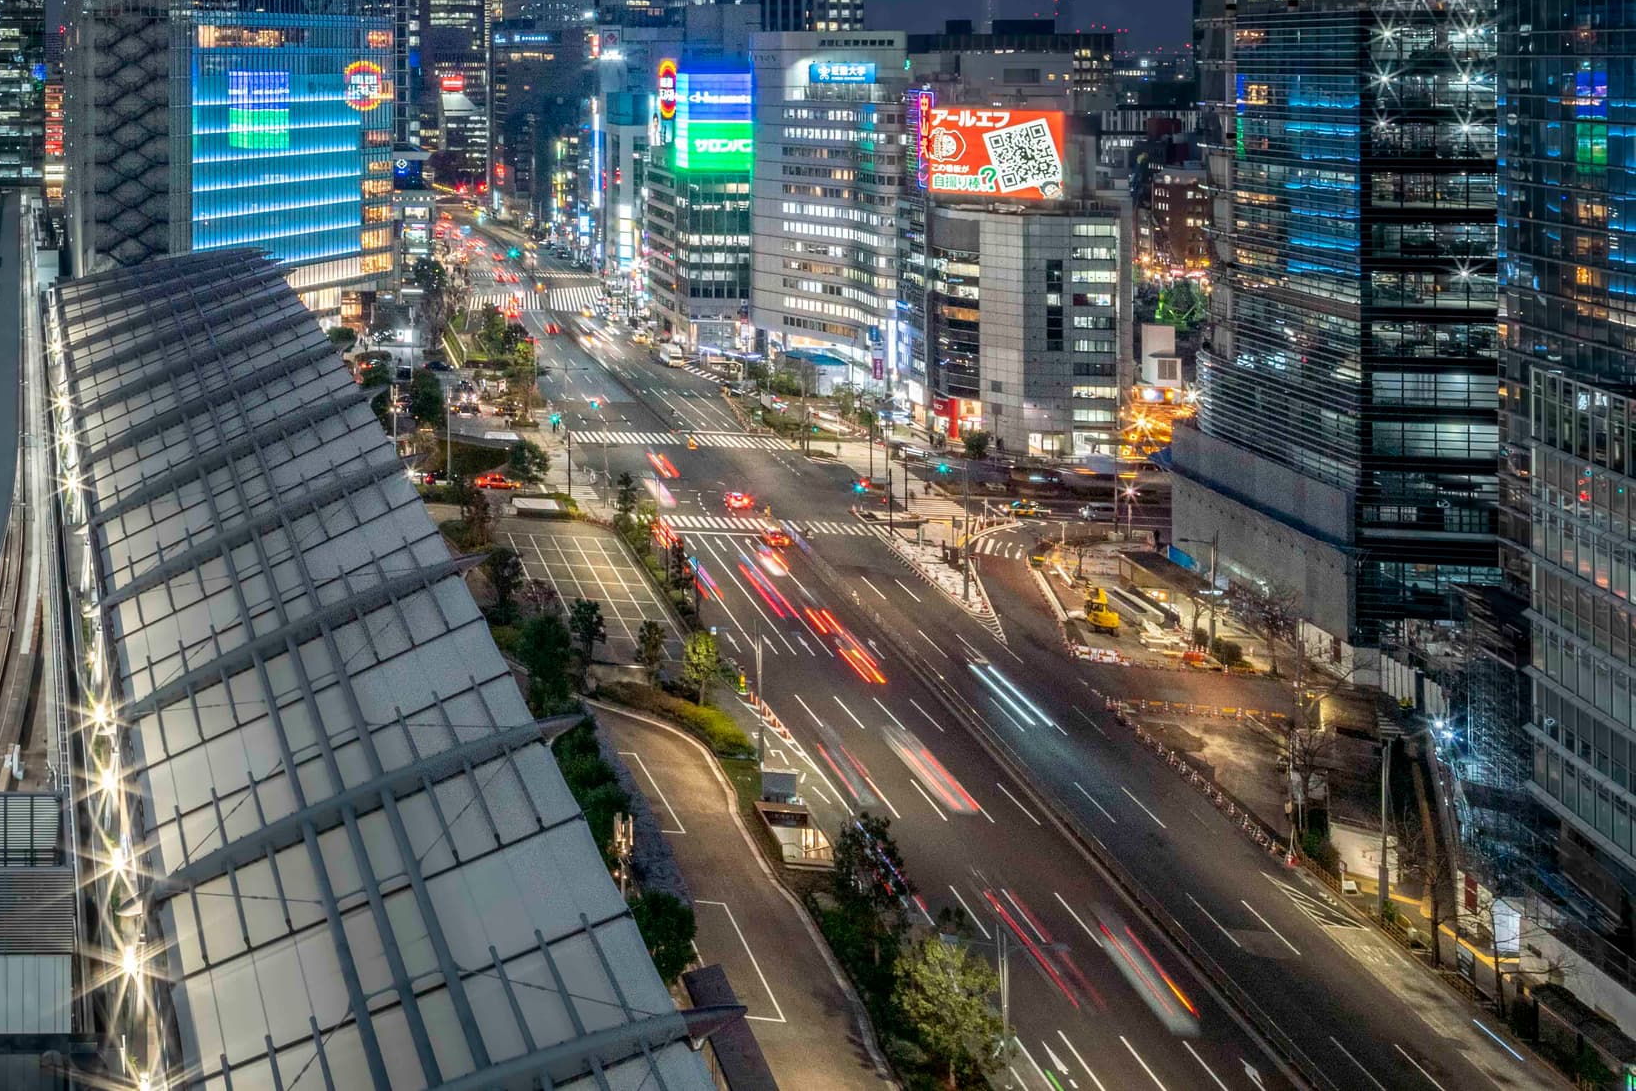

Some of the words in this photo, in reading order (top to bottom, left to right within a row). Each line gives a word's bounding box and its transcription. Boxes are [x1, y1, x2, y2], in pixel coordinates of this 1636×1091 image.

[931, 110, 1010, 128] アールエフ
